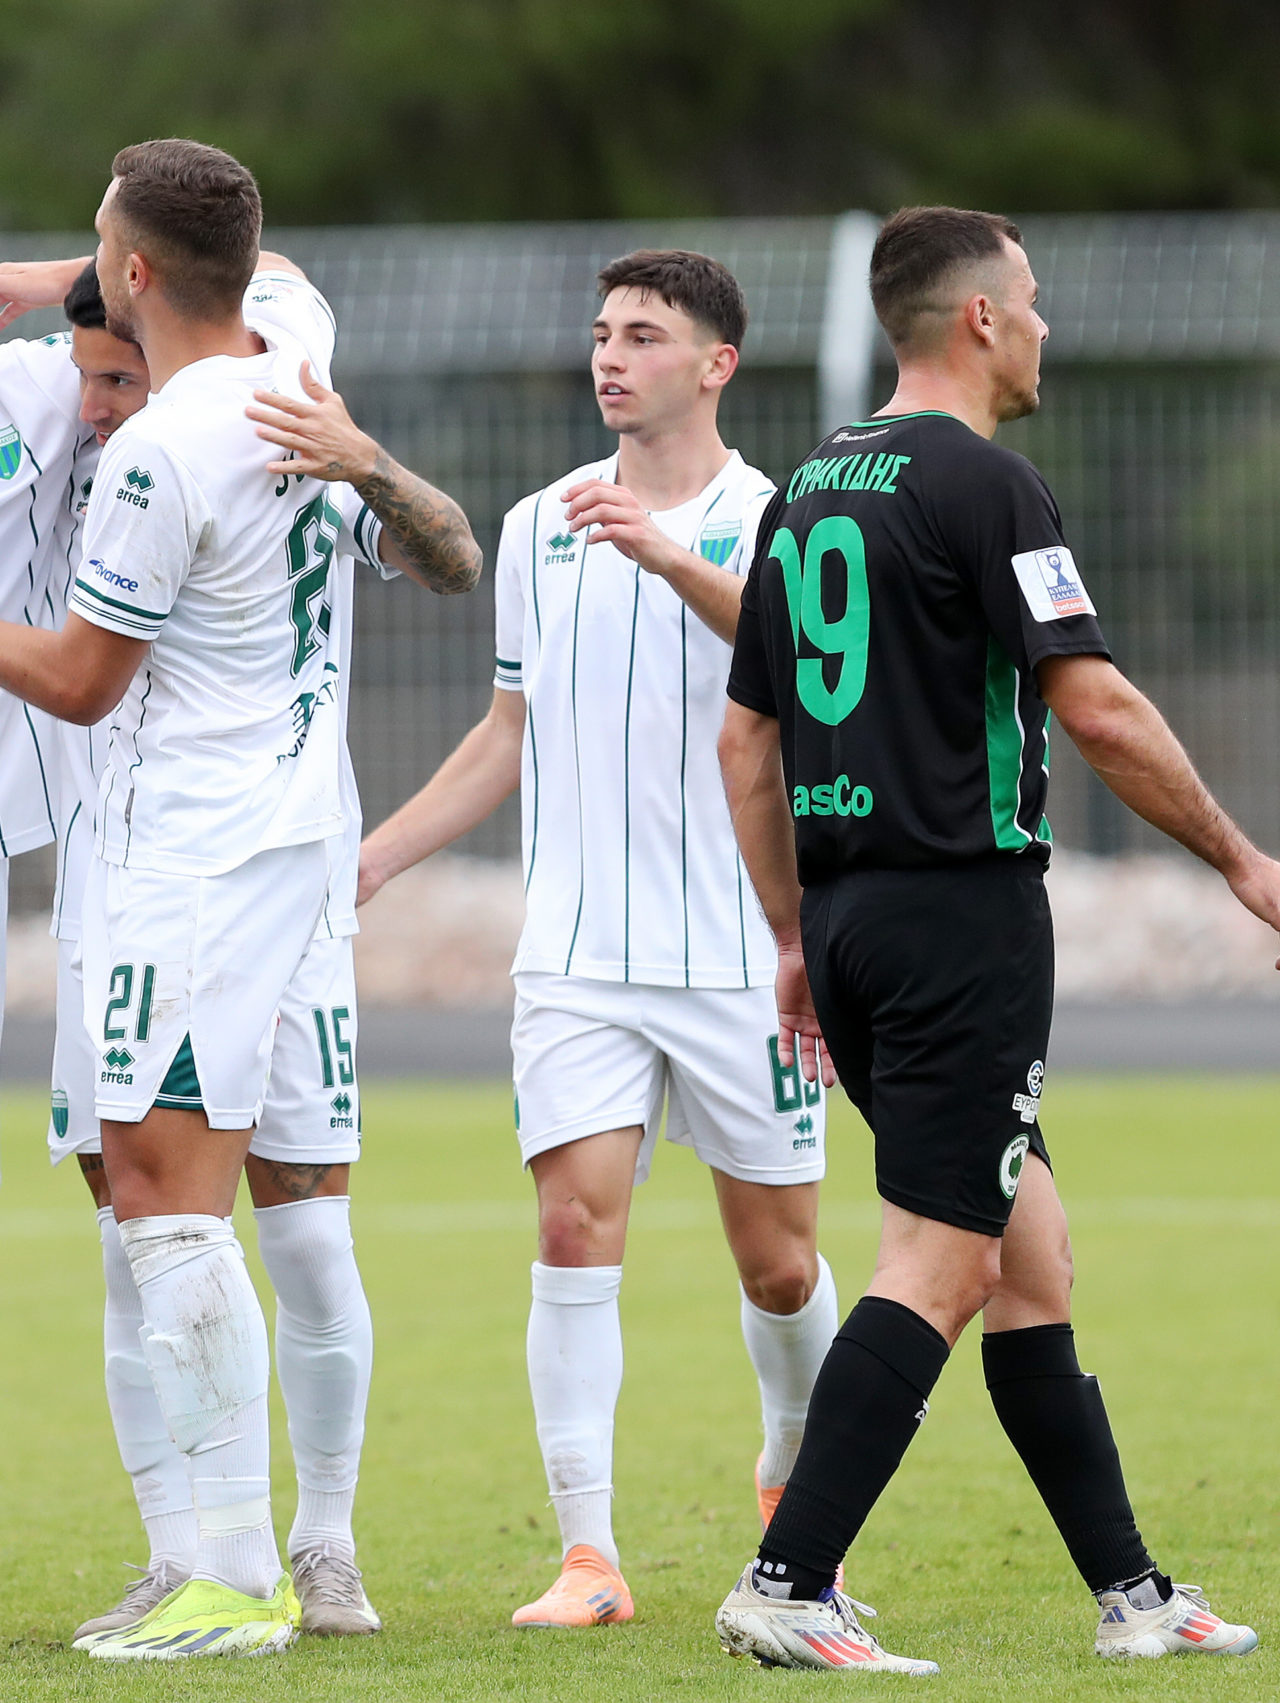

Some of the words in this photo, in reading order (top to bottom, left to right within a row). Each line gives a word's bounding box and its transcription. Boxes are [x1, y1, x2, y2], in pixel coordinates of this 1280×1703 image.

[116, 488, 150, 510] errea
[544, 552, 576, 566] errea
[768, 515, 870, 727] 19
[103, 963, 158, 1043] 21
[312, 1006, 354, 1088] 15
[101, 1070, 133, 1086] errea
[330, 1115, 353, 1129] errea
